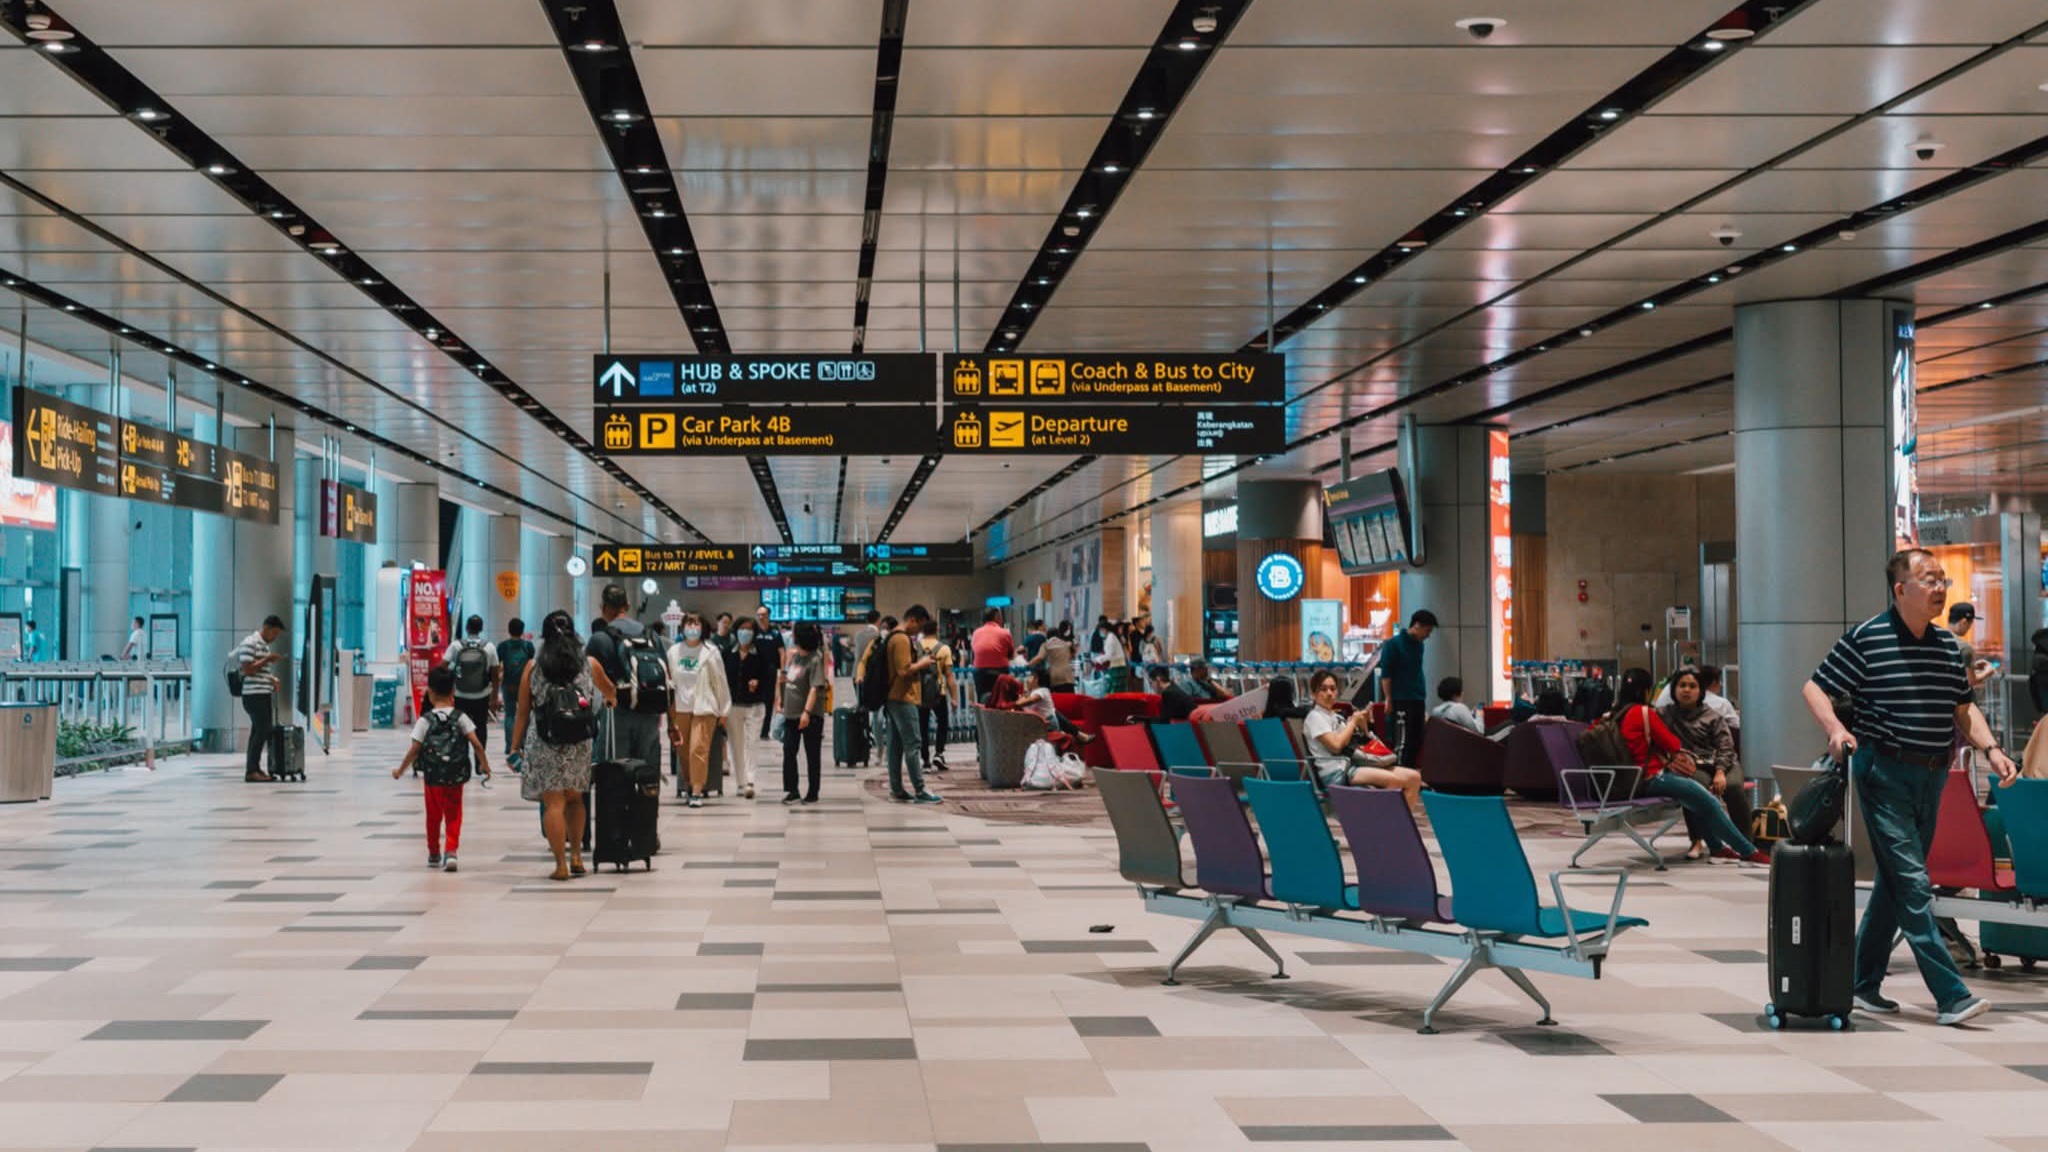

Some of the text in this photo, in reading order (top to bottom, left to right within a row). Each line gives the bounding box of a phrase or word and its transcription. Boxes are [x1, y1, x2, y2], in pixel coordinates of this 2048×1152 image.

[681, 363, 722, 380] HUB
[729, 363, 743, 380] &
[748, 363, 811, 380] SPOKE
[1071, 362, 1255, 383] Coach & Bus to City
[681, 382, 716, 394] (at T2)
[1071, 382, 1222, 394] (via Underpass at Basement)
[648, 418, 668, 444] P
[682, 415, 791, 433] Car Park 4B
[1031, 415, 1128, 435] Departure
[682, 434, 834, 447] (via Underpass at Basement)
[1031, 434, 1090, 446] (at Level 2)
